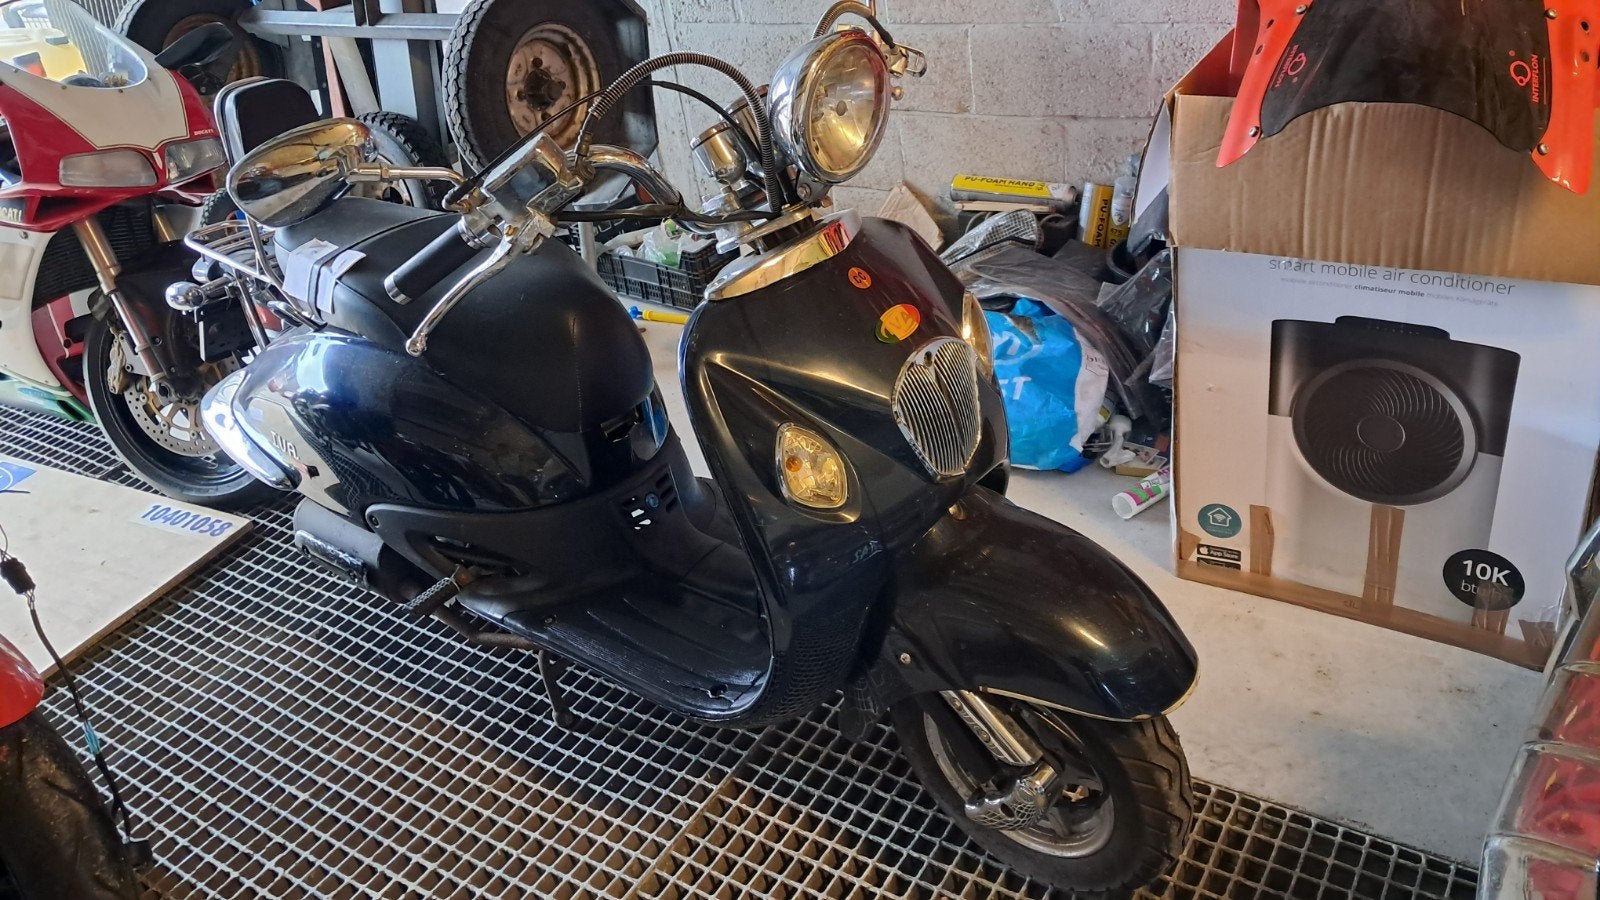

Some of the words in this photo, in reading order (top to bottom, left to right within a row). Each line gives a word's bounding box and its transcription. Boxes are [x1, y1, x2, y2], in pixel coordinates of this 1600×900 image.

[1531, 54, 1539, 103] INTERFLON
[964, 176, 1007, 185] PU-FOAM
[1269, 259, 1316, 274] smart
[1321, 263, 1378, 280] mobile
[1382, 268, 1405, 281] air
[1410, 272, 1516, 295] conditioner
[1354, 284, 1397, 294] climatiseur
[1398, 288, 1425, 297] mobile
[141, 504, 233, 537] 10401058
[1463, 560, 1511, 587] 10K
